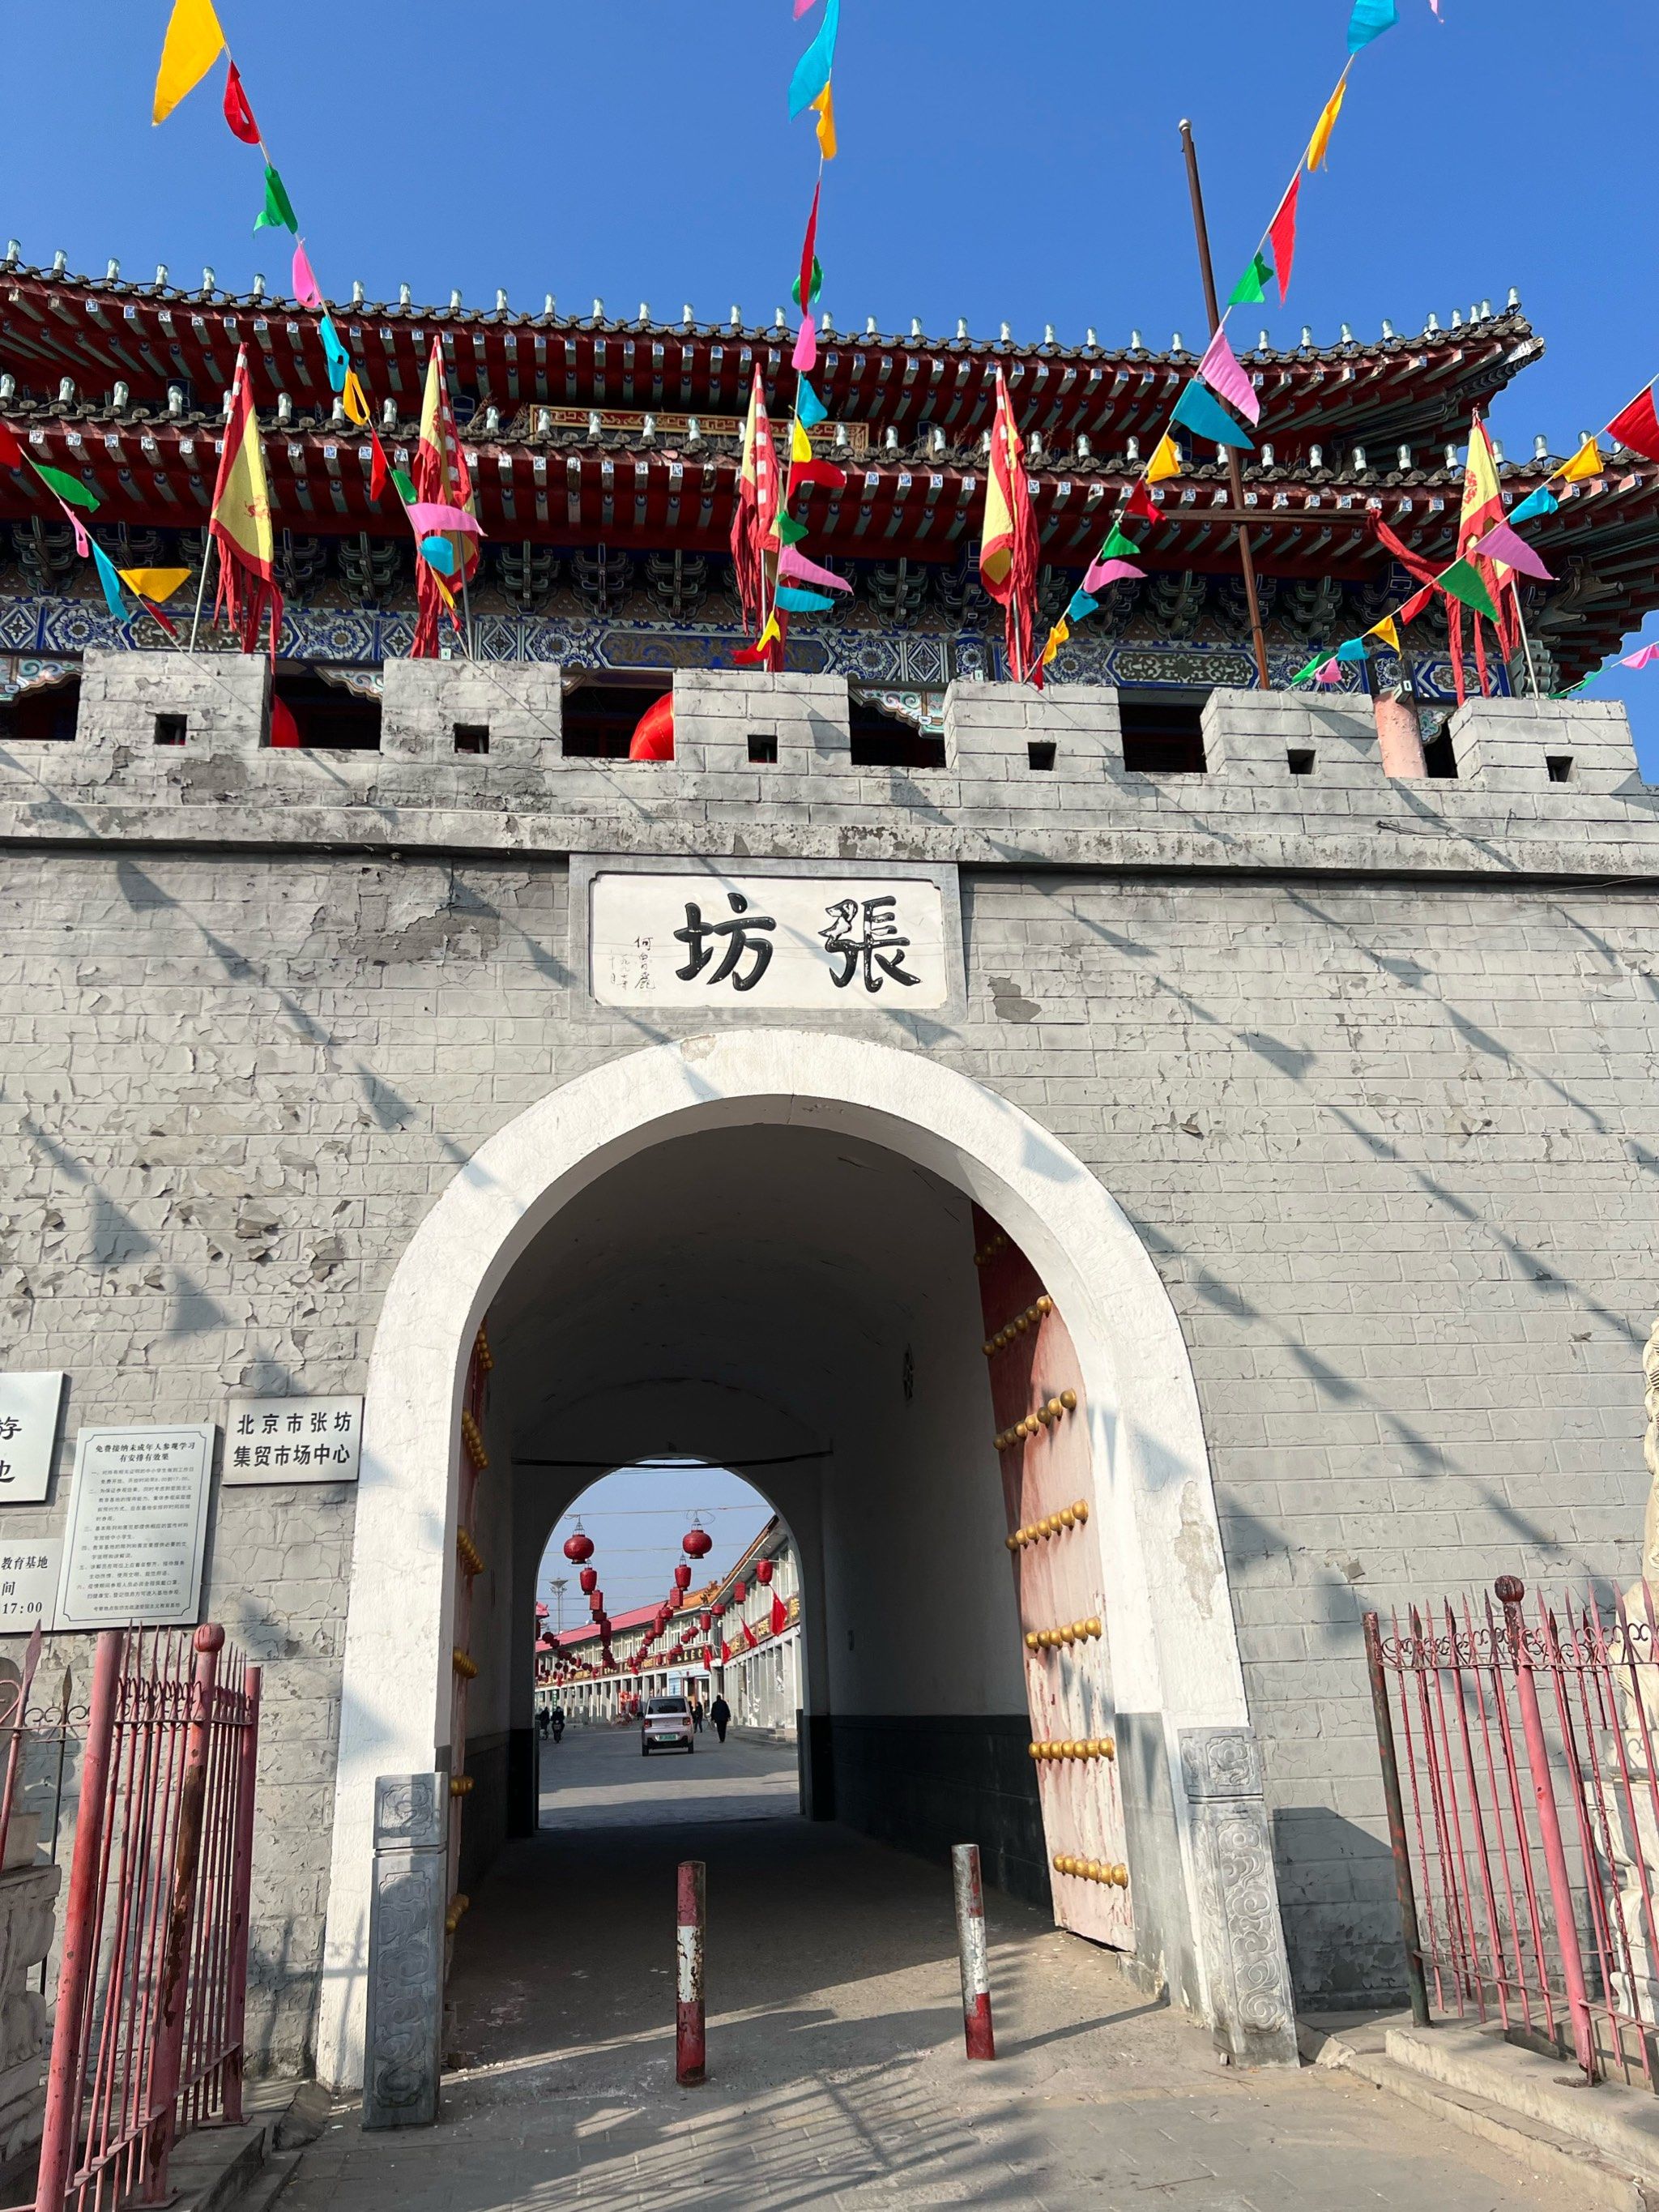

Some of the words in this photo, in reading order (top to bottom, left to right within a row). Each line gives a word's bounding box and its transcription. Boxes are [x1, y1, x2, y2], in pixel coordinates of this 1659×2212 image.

[237, 1411, 352, 1435] 北京市张坊
[233, 1443, 351, 1467] 集贸市场中心
[2, 1581, 16, 1596] 间
[2, 1601, 42, 1615] 17:00
